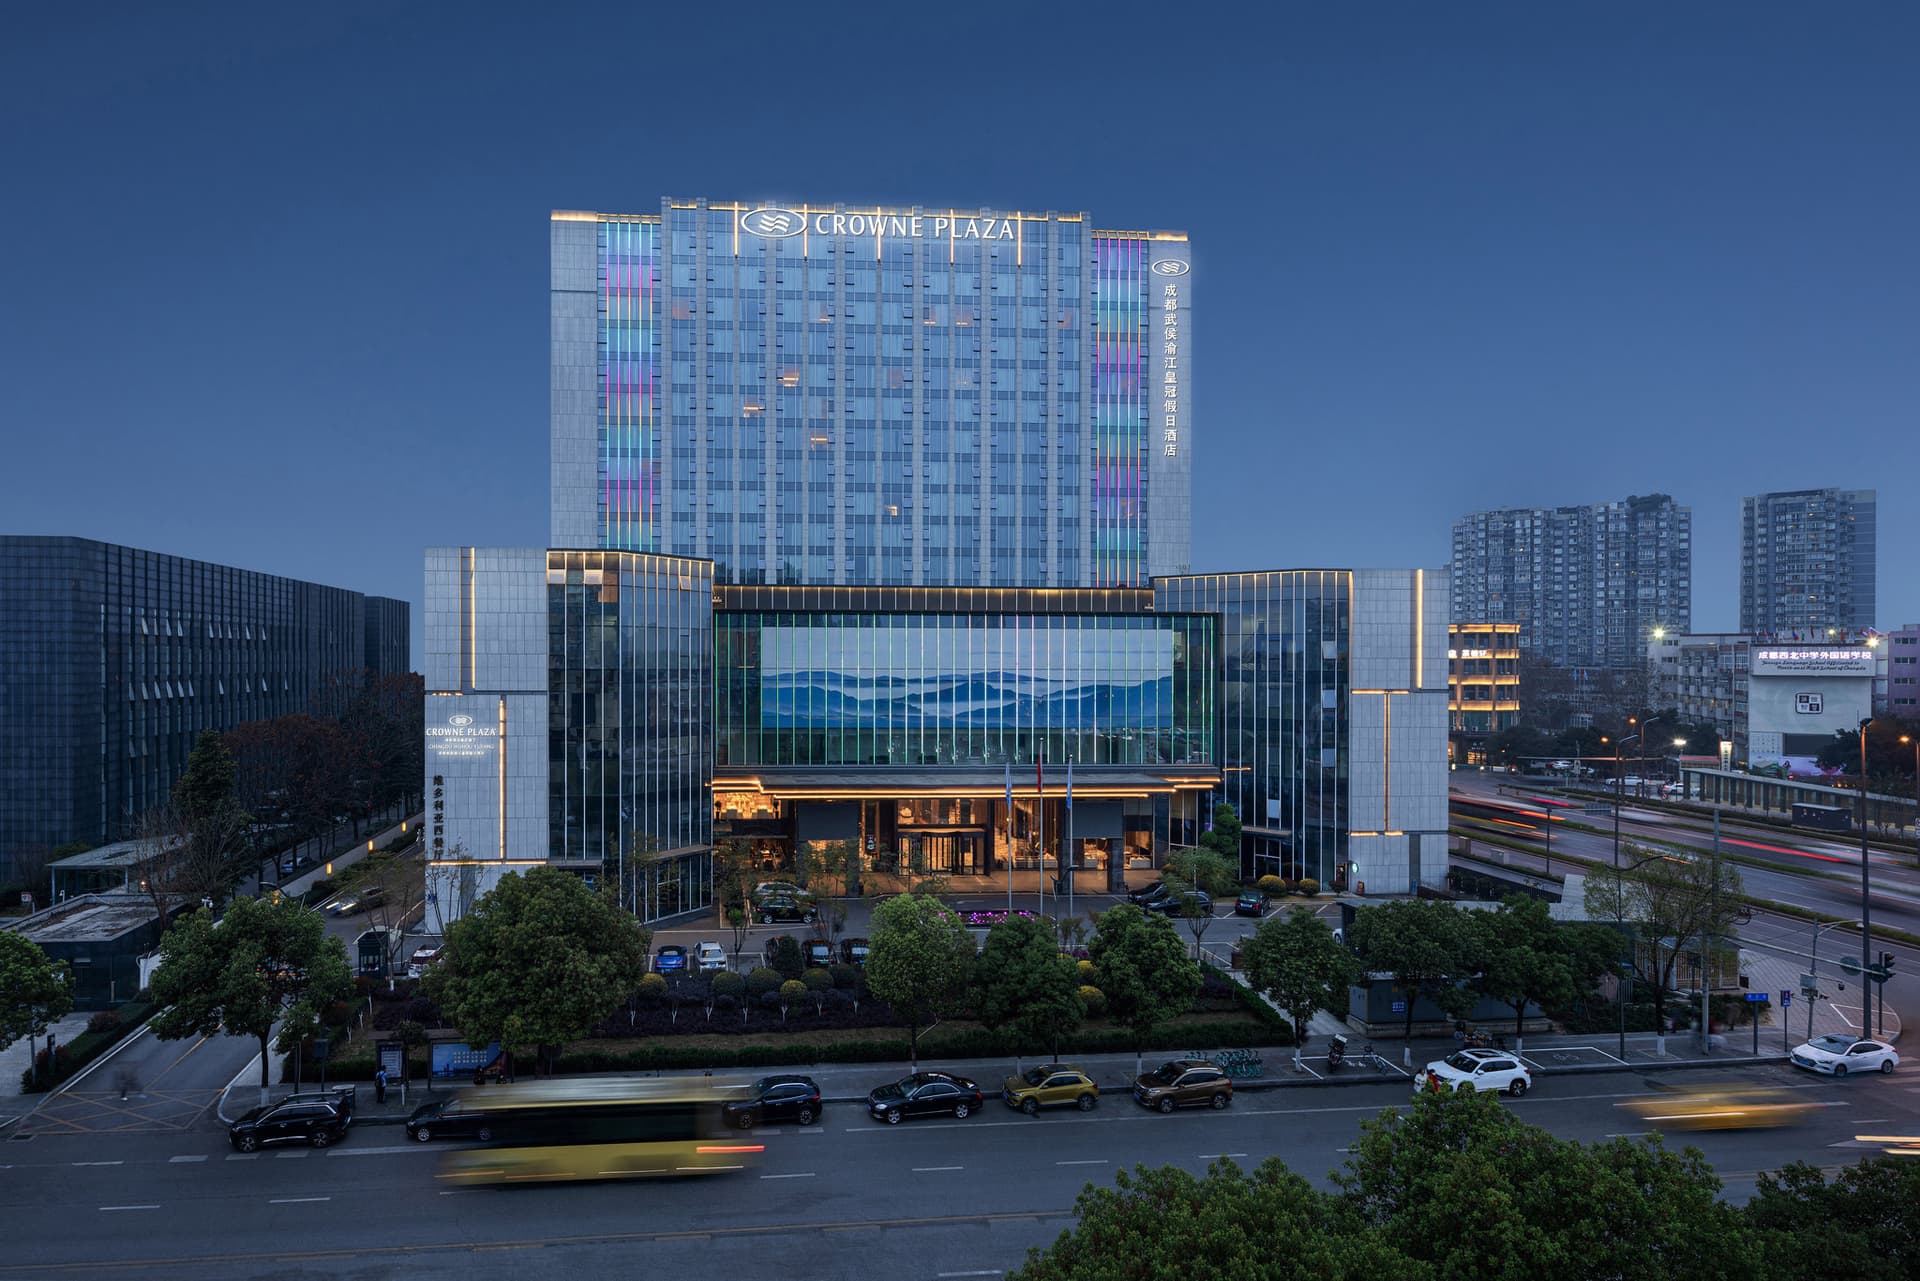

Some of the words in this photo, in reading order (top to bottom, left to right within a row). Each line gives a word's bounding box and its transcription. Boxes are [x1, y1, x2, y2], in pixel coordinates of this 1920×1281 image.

[815, 213, 924, 238] CROWNE
[935, 217, 1015, 240] PLAZA
[1164, 283, 1178, 457] 成都武侯渝江皇冠假日酒店
[1758, 651, 1872, 660] 成都西北中学外国语学校
[426, 727, 464, 736] CROWNE
[467, 727, 496, 736] PLAZA
